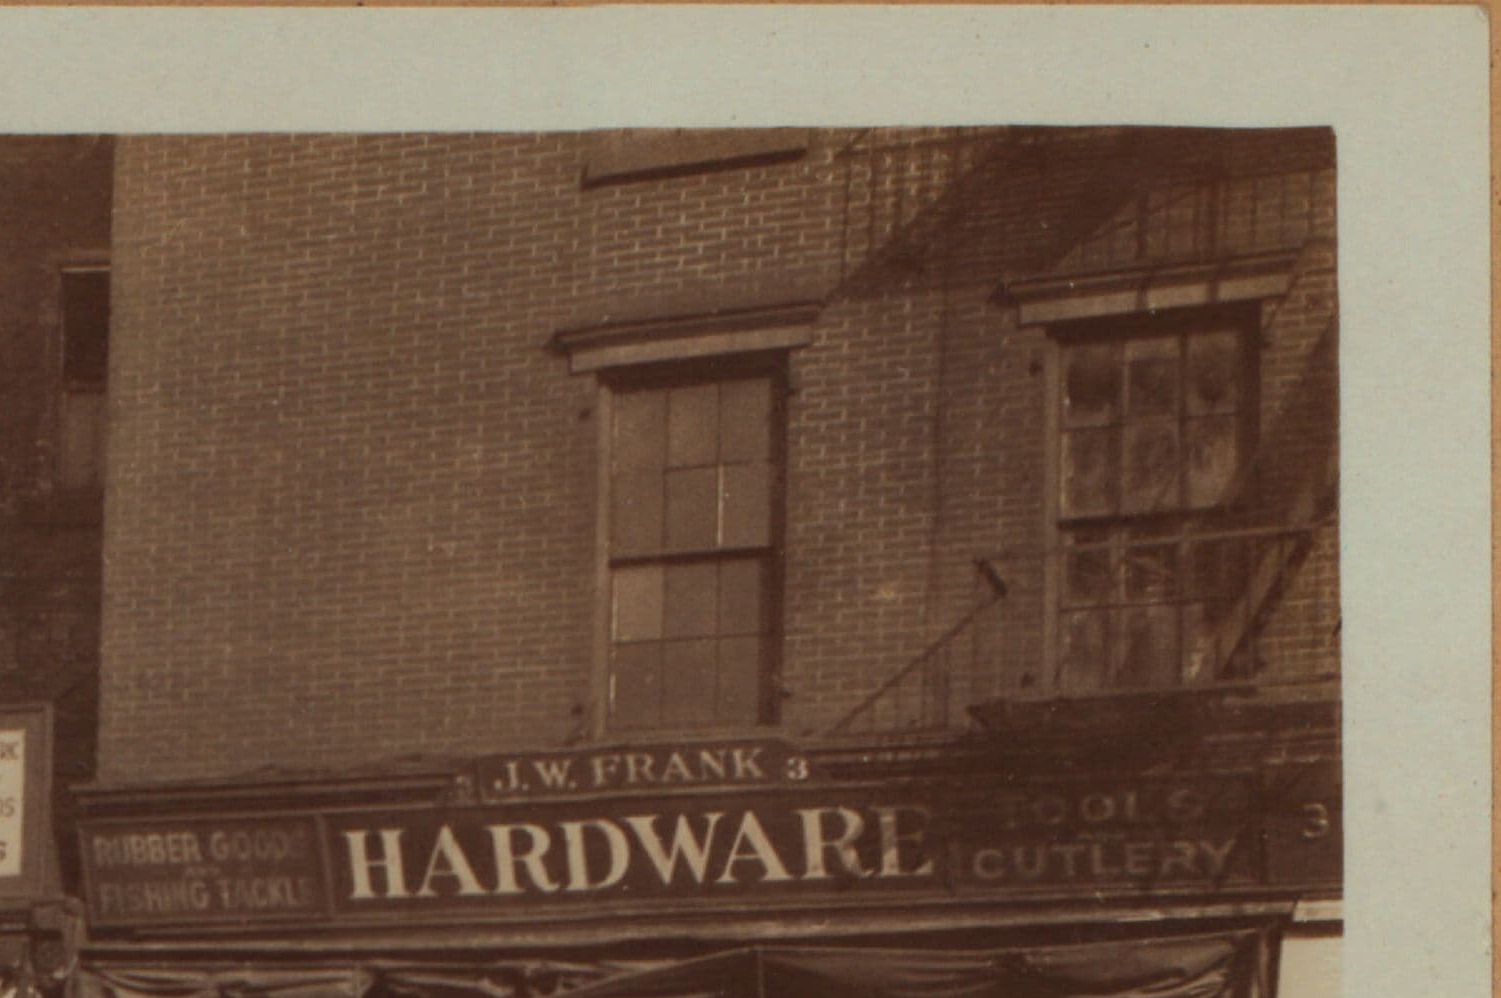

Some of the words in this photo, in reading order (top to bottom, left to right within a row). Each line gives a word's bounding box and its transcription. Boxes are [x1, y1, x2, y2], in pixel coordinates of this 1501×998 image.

[590, 747, 764, 788] FRANK
[785, 755, 810, 781] 3
[1301, 802, 1330, 839] 3
[93, 831, 203, 866] RUBBER
[343, 803, 936, 901] HARDWARE
[971, 837, 1237, 881] CUTLERY
[98, 879, 210, 914] FISHING
